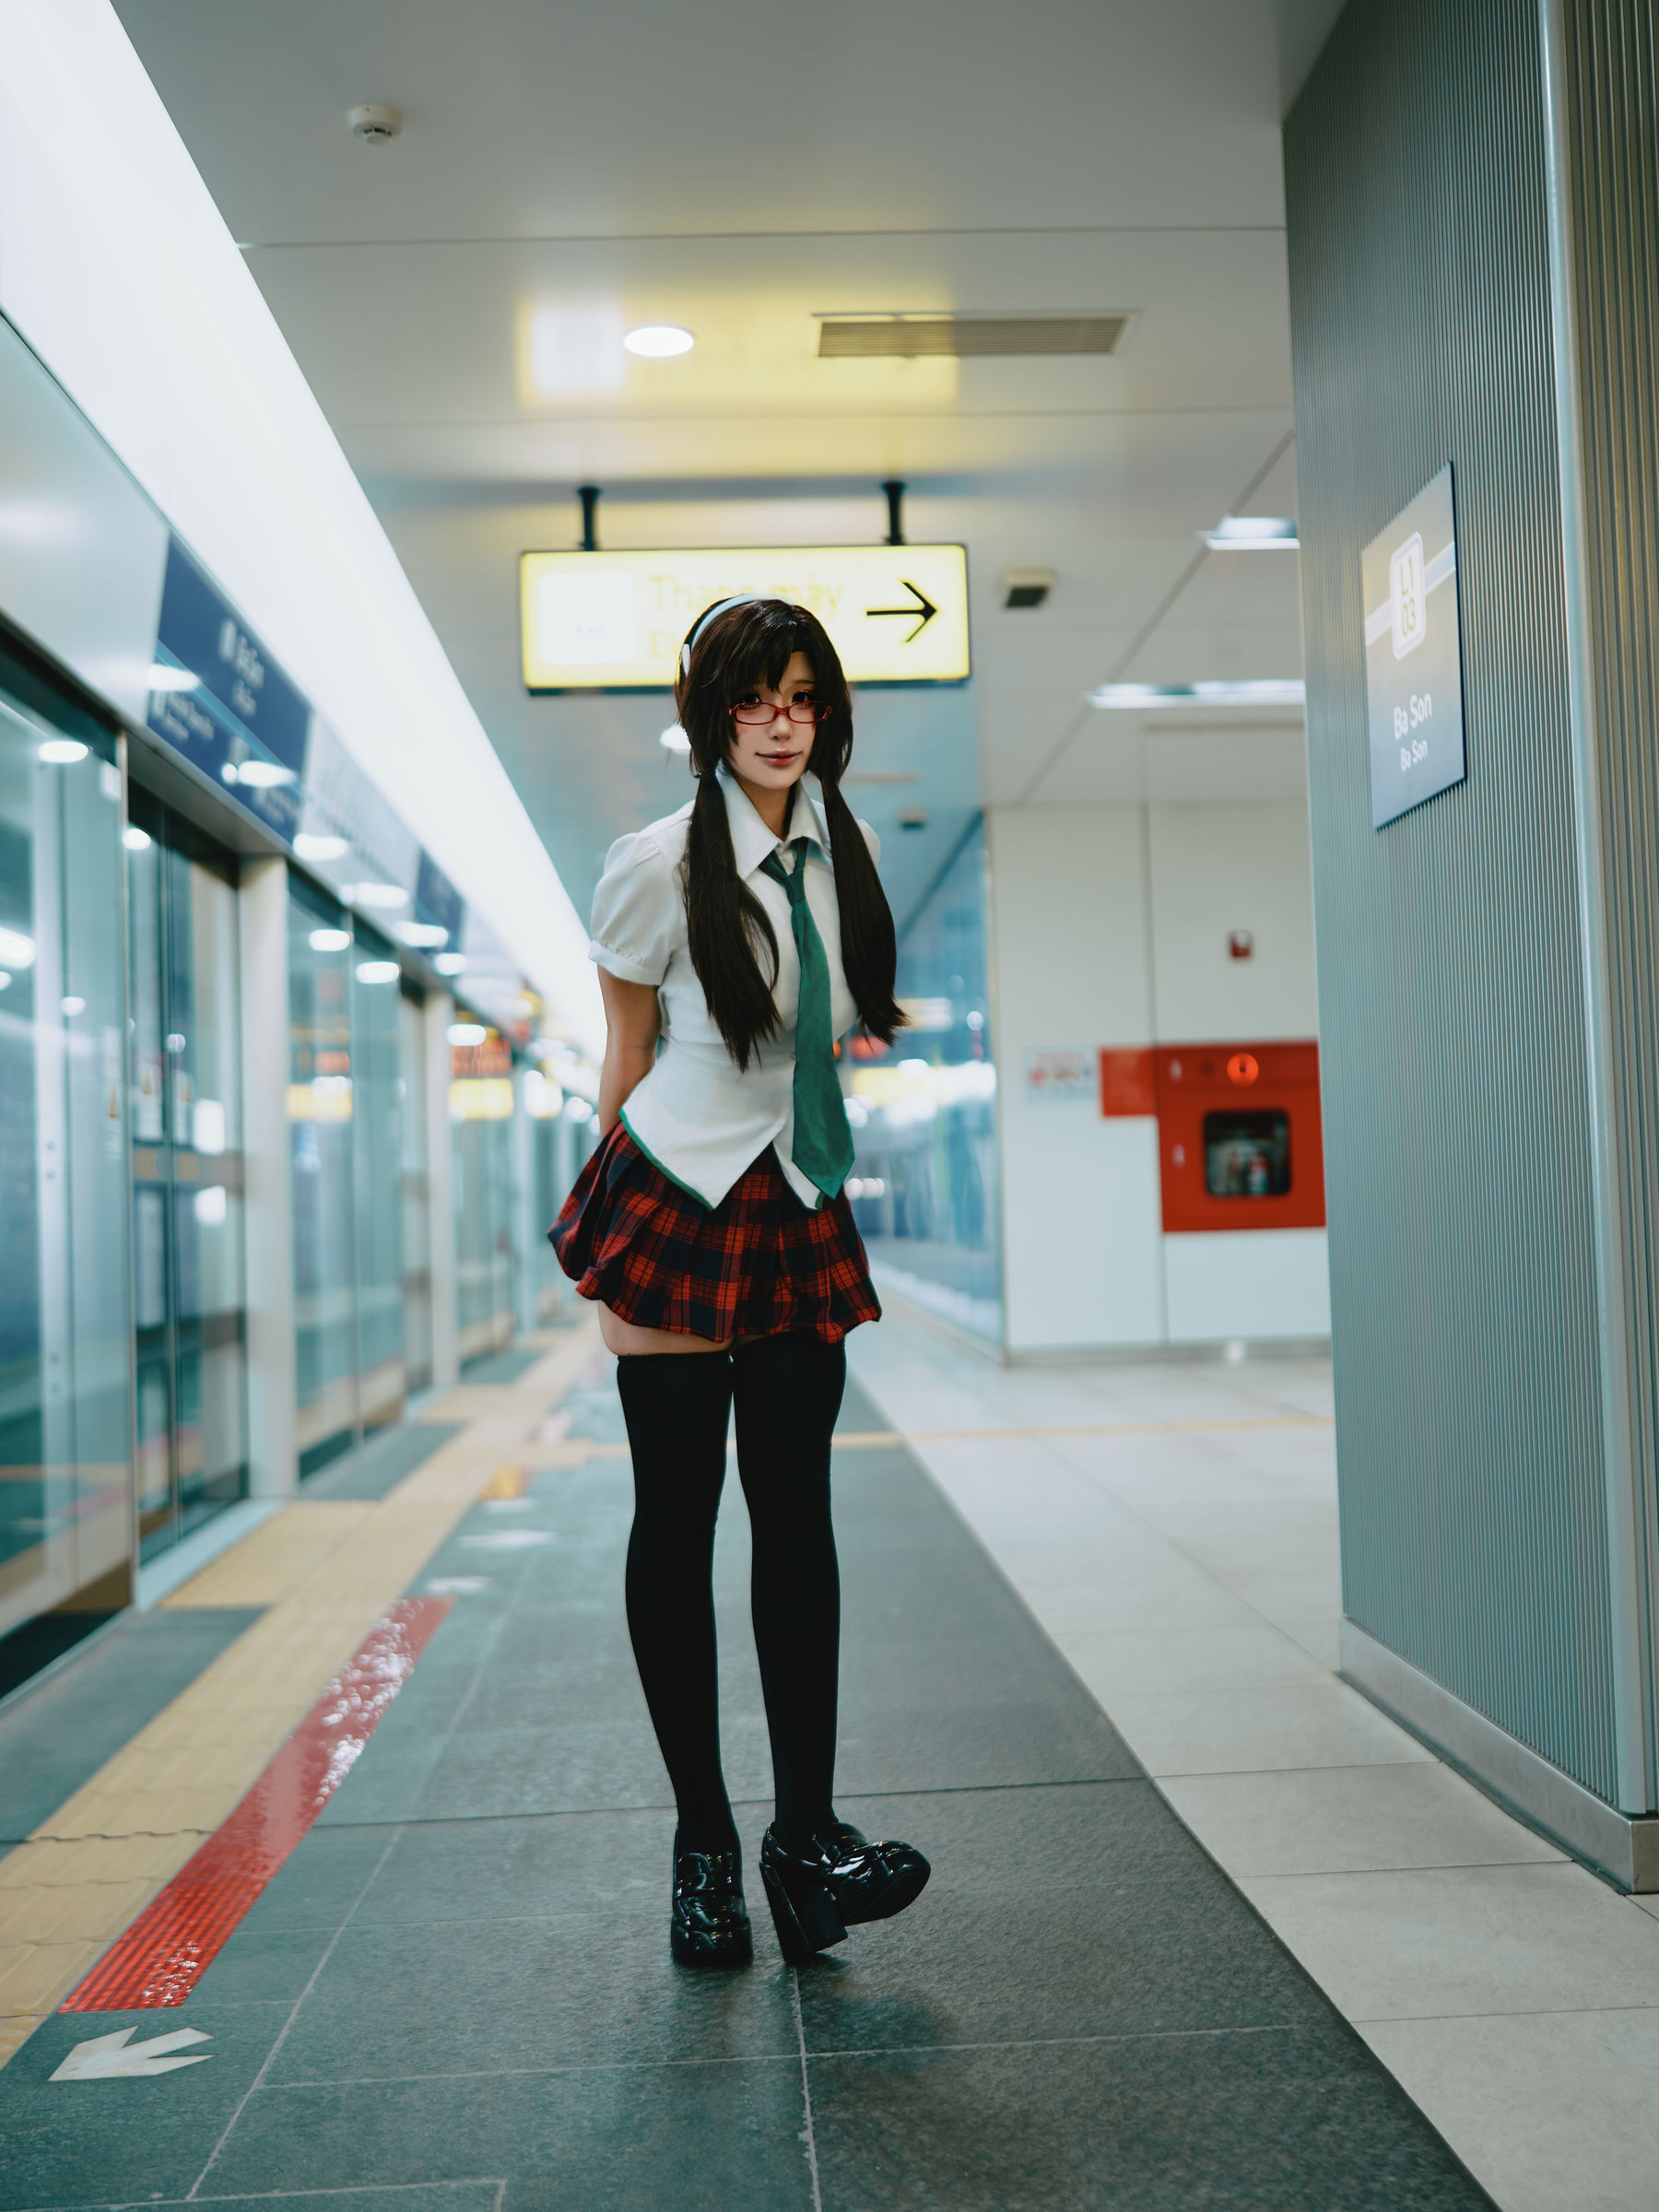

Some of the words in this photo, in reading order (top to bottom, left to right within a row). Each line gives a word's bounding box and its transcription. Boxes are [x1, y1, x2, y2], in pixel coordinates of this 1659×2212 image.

[1401, 595, 1417, 638] 03
[1393, 705, 1408, 741] Ba
[1409, 692, 1432, 729] Son
[1400, 747, 1412, 772] Ba
[1411, 738, 1429, 765] Son
